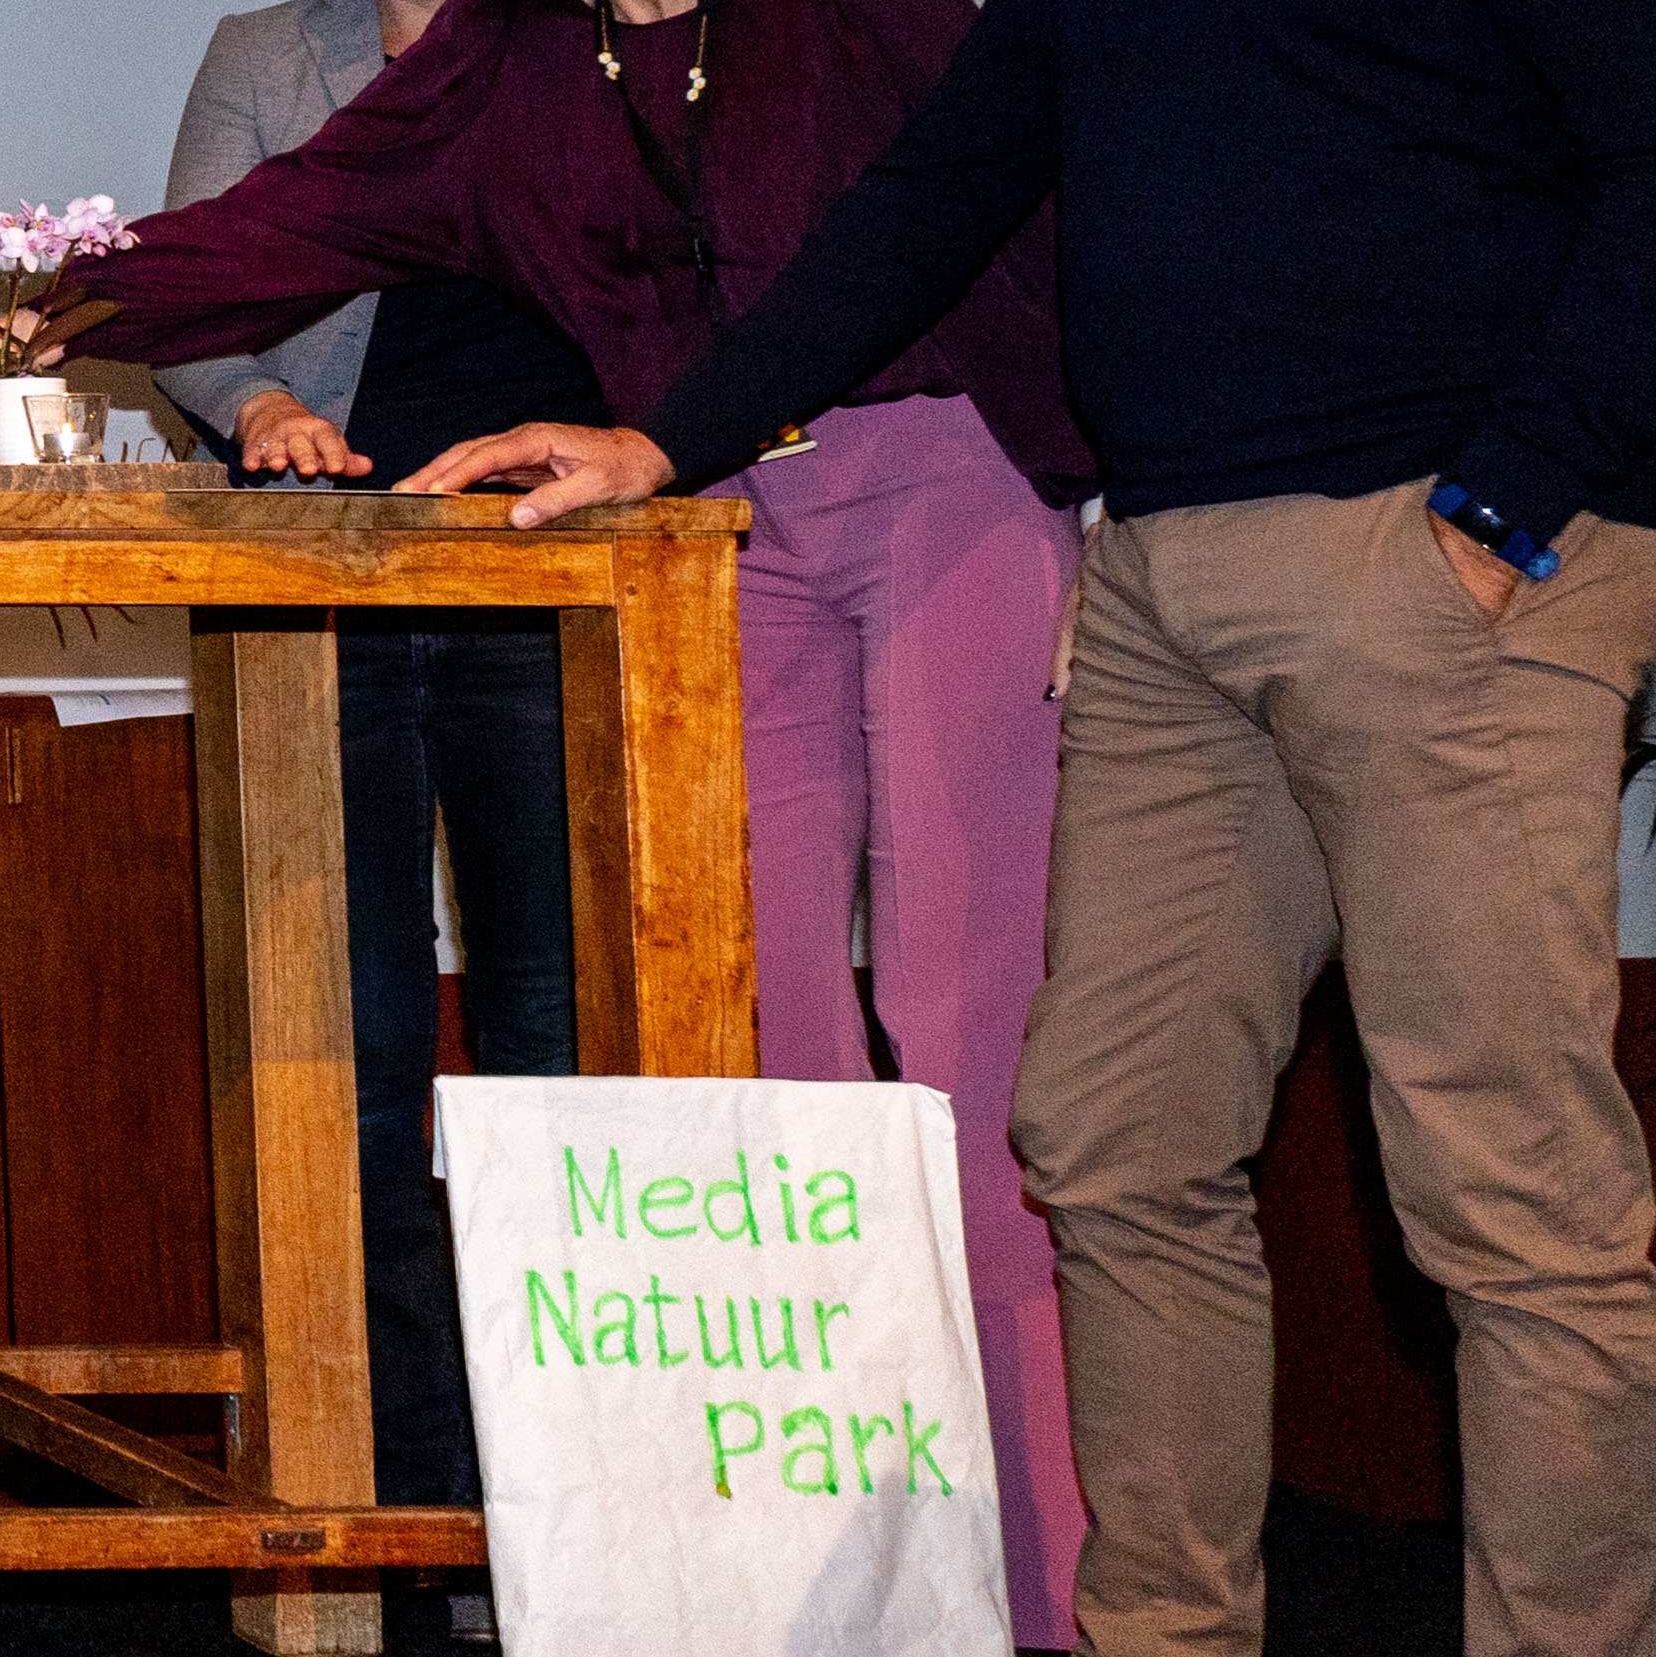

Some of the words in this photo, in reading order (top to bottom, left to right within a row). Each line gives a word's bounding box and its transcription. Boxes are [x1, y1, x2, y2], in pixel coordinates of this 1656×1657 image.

[562, 1145, 862, 1249] Media
[524, 1269, 852, 1373] Natuur
[704, 1399, 954, 1500] Park
